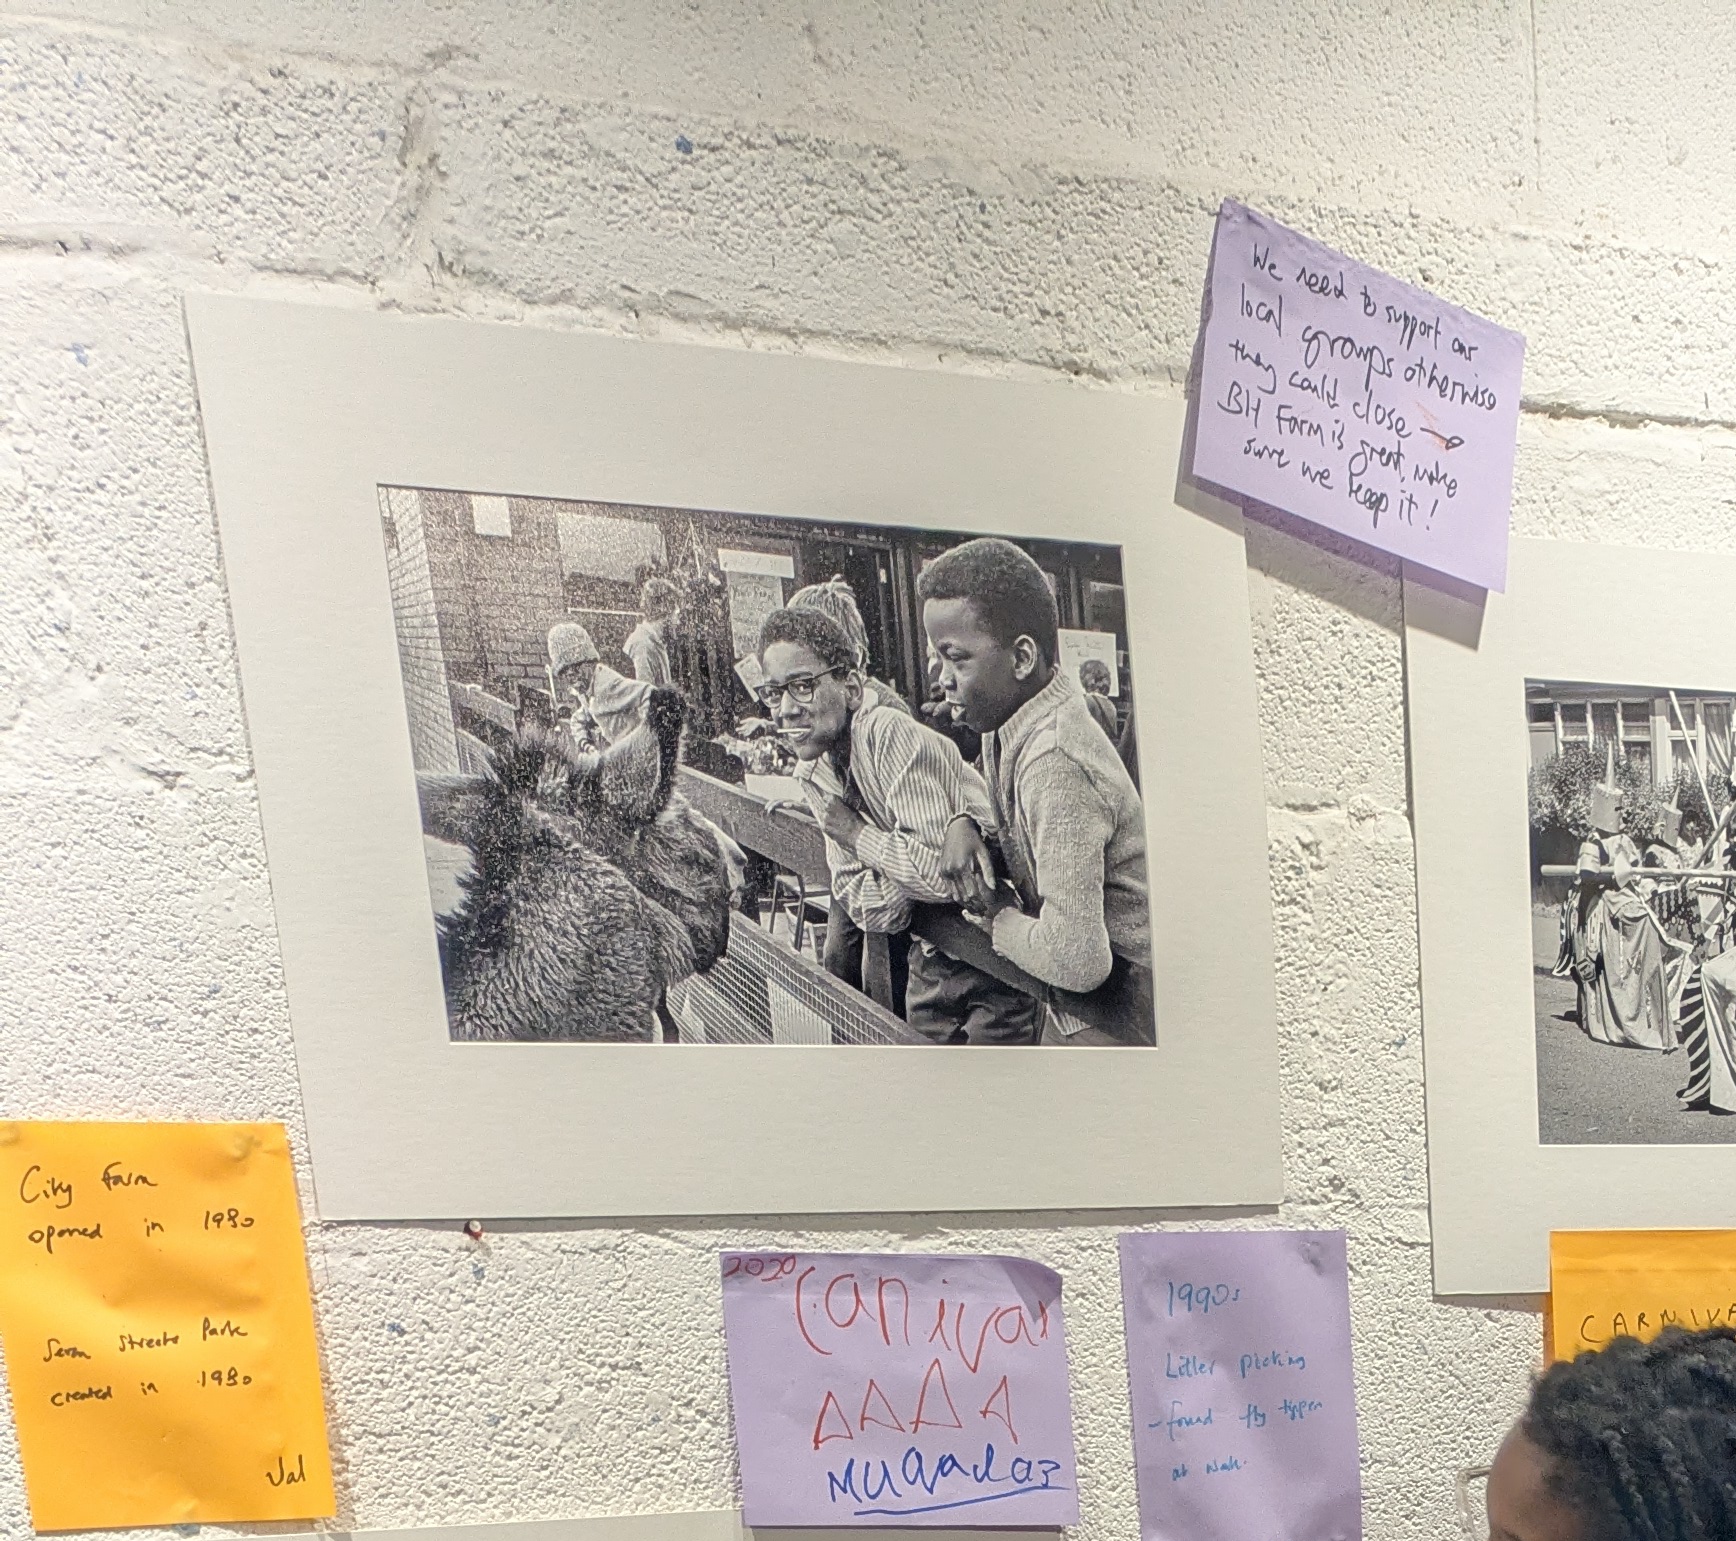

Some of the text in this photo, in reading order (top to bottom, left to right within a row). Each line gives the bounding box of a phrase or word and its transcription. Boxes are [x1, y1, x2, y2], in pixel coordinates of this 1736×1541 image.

[1253, 244, 1478, 362] We need to support our
[1241, 283, 1497, 410] local groups otherwise
[1229, 340, 1412, 438] they could close
[1217, 381, 1262, 428] BH
[1275, 405, 1325, 447] Farm
[1332, 419, 1345, 450] is
[1413, 464, 1458, 497] make
[1244, 438, 1290, 468] sure
[1302, 461, 1333, 489] we
[20, 1161, 158, 1209] City Farm
[28, 1208, 254, 1253] opened in 1980
[202, 1317, 249, 1341] Park
[51, 1367, 252, 1407] created in 1980
[1239, 1403, 1266, 1429] fly
[266, 1454, 307, 1487] Val
